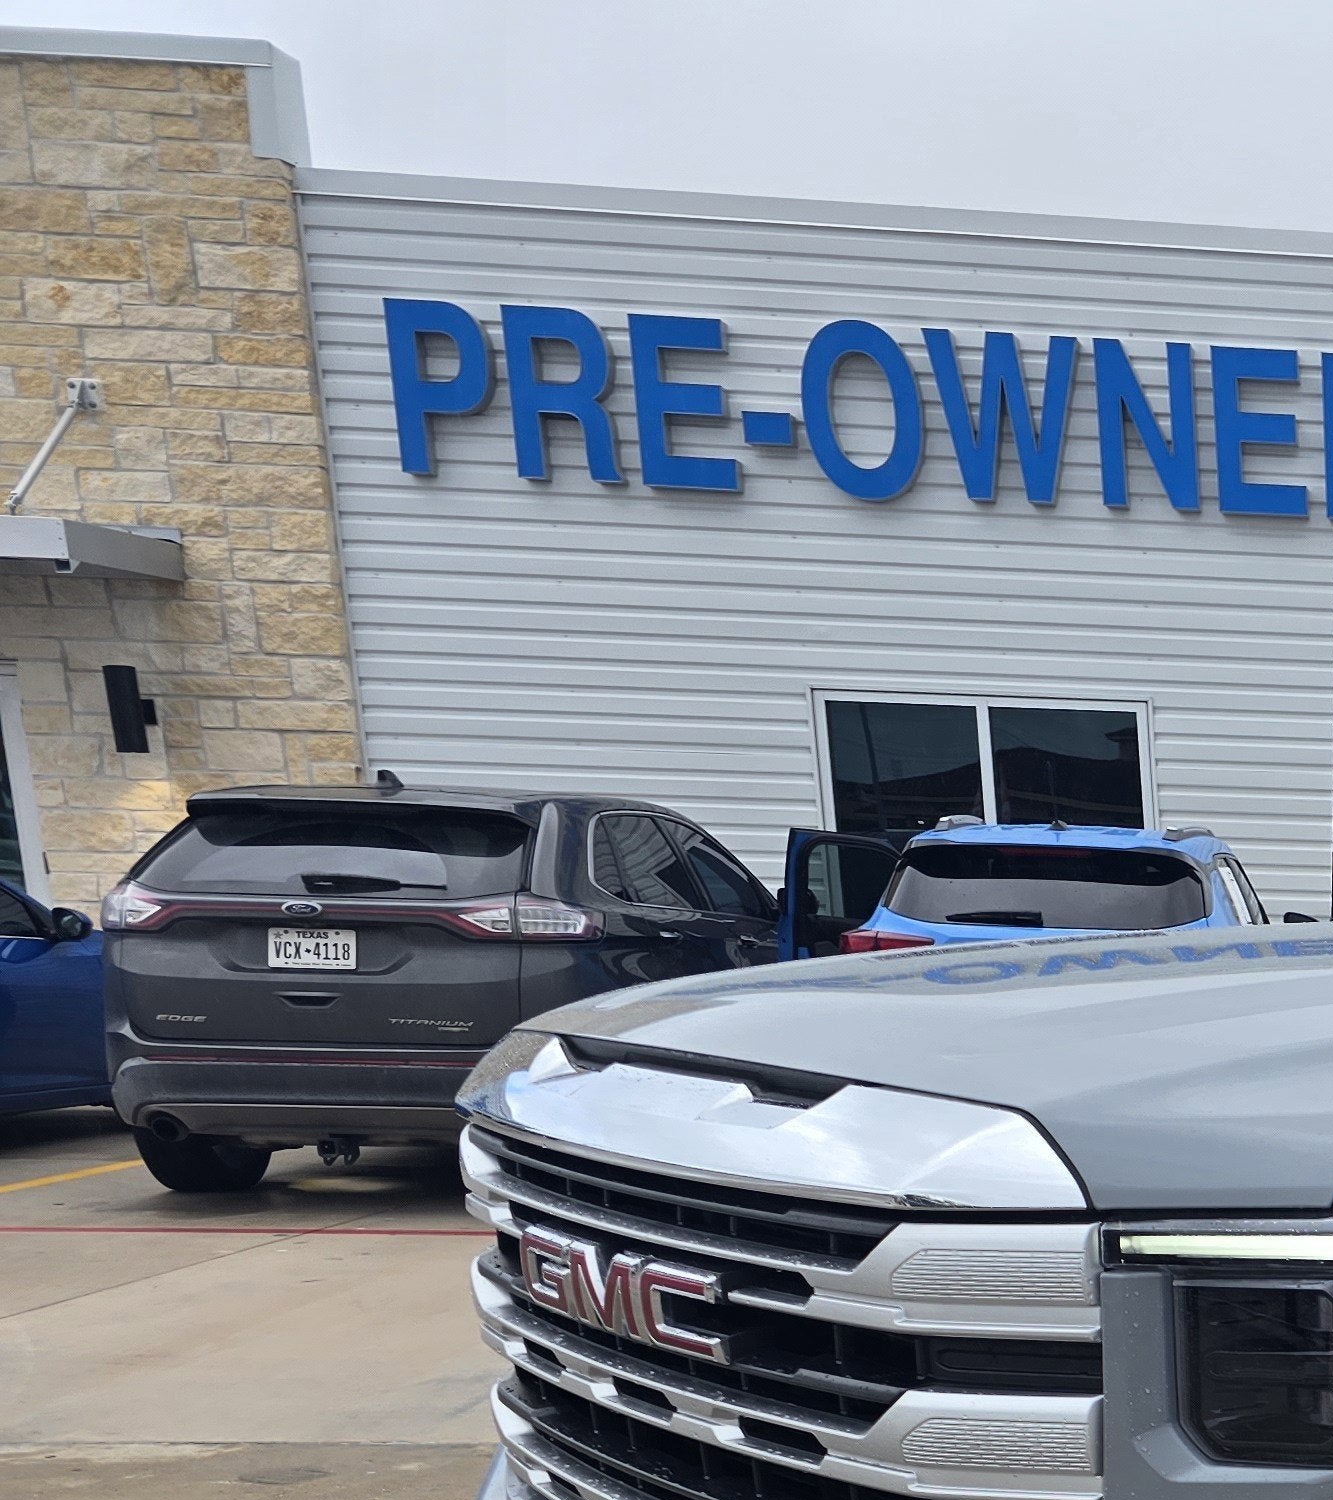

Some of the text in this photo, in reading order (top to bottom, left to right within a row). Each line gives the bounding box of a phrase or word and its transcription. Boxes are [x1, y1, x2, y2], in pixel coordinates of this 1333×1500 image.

[296, 930, 329, 940] TEXAS
[274, 941, 350, 961] VCX 4118
[156, 1014, 207, 1023] EDGE
[388, 1017, 474, 1027] TITANIUM
[520, 1225, 730, 1366] GMC
